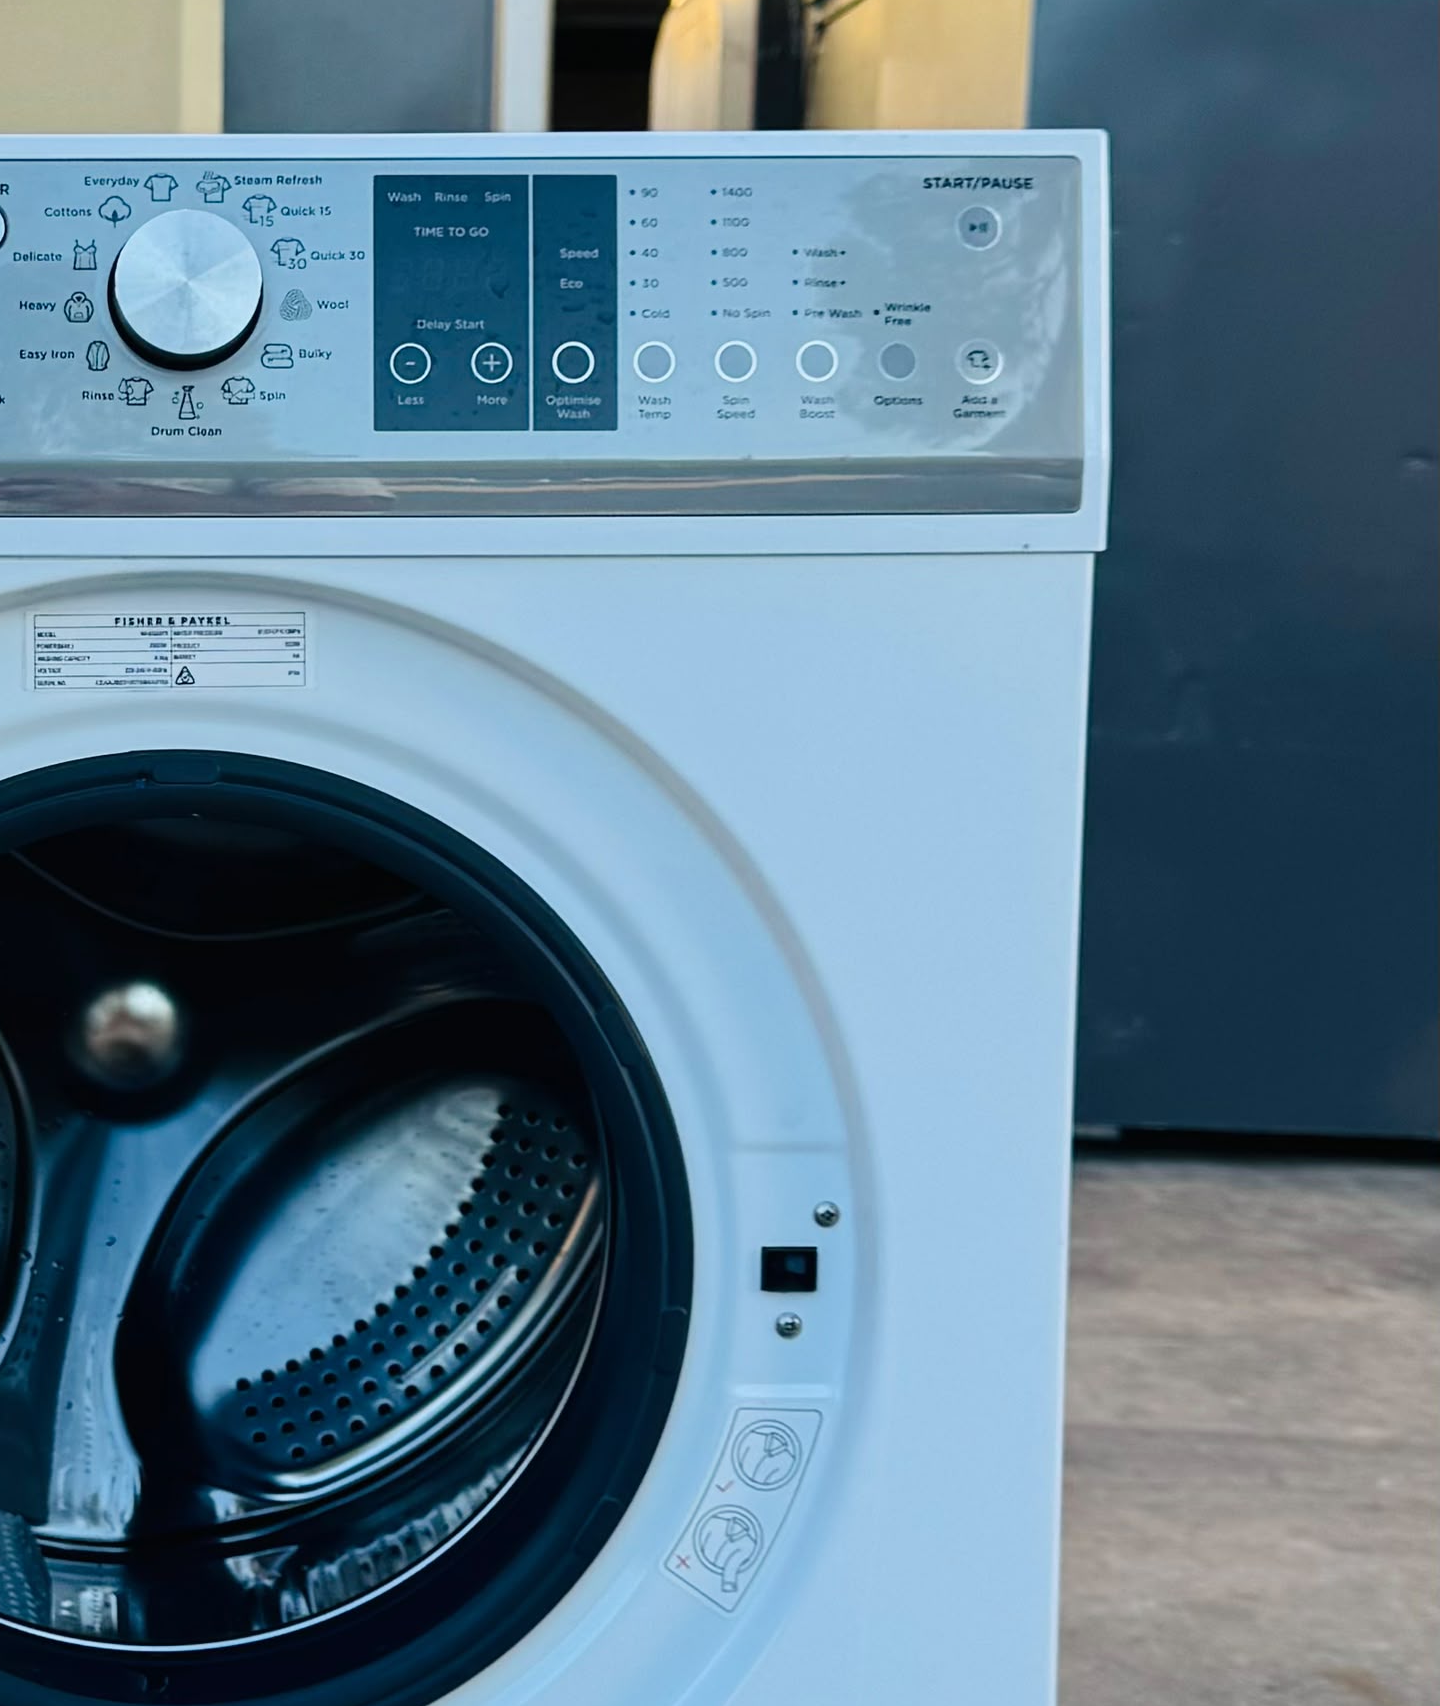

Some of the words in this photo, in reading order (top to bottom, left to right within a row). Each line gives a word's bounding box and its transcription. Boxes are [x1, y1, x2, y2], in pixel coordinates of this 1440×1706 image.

[84, 176, 140, 188] Everyday
[233, 176, 273, 186] Steam
[276, 175, 323, 186] Refresh
[922, 177, 1034, 189] START/PAUSE
[387, 192, 422, 203] Wash
[434, 192, 468, 203] Rinse
[484, 192, 512, 204] Spin
[640, 188, 659, 199] 90
[721, 187, 753, 198] 1400
[43, 208, 92, 218] Cottons
[280, 206, 316, 217] Quick
[319, 206, 332, 216] 15
[256, 215, 275, 227] 15
[640, 218, 659, 229] 60
[722, 218, 751, 228] 1100
[413, 227, 444, 238] TIME
[447, 227, 466, 238] TO
[468, 227, 490, 238] GO
[12, 252, 63, 262] Delicate
[310, 251, 346, 261] Quick
[349, 251, 366, 261] 30
[559, 248, 600, 260] Speed
[641, 248, 659, 258] 40
[721, 247, 749, 258] 800
[284, 258, 308, 270] 30
[559, 278, 584, 289] Eco
[642, 279, 660, 289] 30
[722, 277, 749, 288] 500
[19, 301, 57, 313] Heavy
[316, 301, 349, 310] Wool
[884, 303, 932, 313] Wrinkle
[641, 309, 671, 319] Cold
[722, 309, 741, 319] No
[743, 308, 772, 319] Spin
[804, 309, 826, 319] Pre
[828, 309, 863, 319] Wash
[416, 320, 452, 332] Delay
[454, 319, 485, 330] Start
[884, 316, 913, 326] Free
[19, 350, 48, 361] Easy
[51, 350, 75, 360] Iron
[298, 349, 333, 361] Bulky
[81, 391, 115, 401] Rinse
[259, 391, 286, 402] Spin
[397, 395, 425, 406] Less
[476, 395, 509, 406] More
[545, 395, 602, 407] Optimise
[637, 396, 672, 406] Wash
[722, 395, 750, 406] Spin
[800, 396, 836, 406] Wash
[873, 396, 924, 407] Options
[556, 409, 591, 419] Wash
[638, 409, 672, 421] Temp
[716, 409, 756, 420] Speed
[799, 409, 836, 419] Boost
[151, 427, 185, 437] Drum
[187, 427, 222, 437] Clean
[114, 617, 163, 626] FISHER
[167, 617, 176, 626] &
[180, 617, 231, 626] PAYKEL
